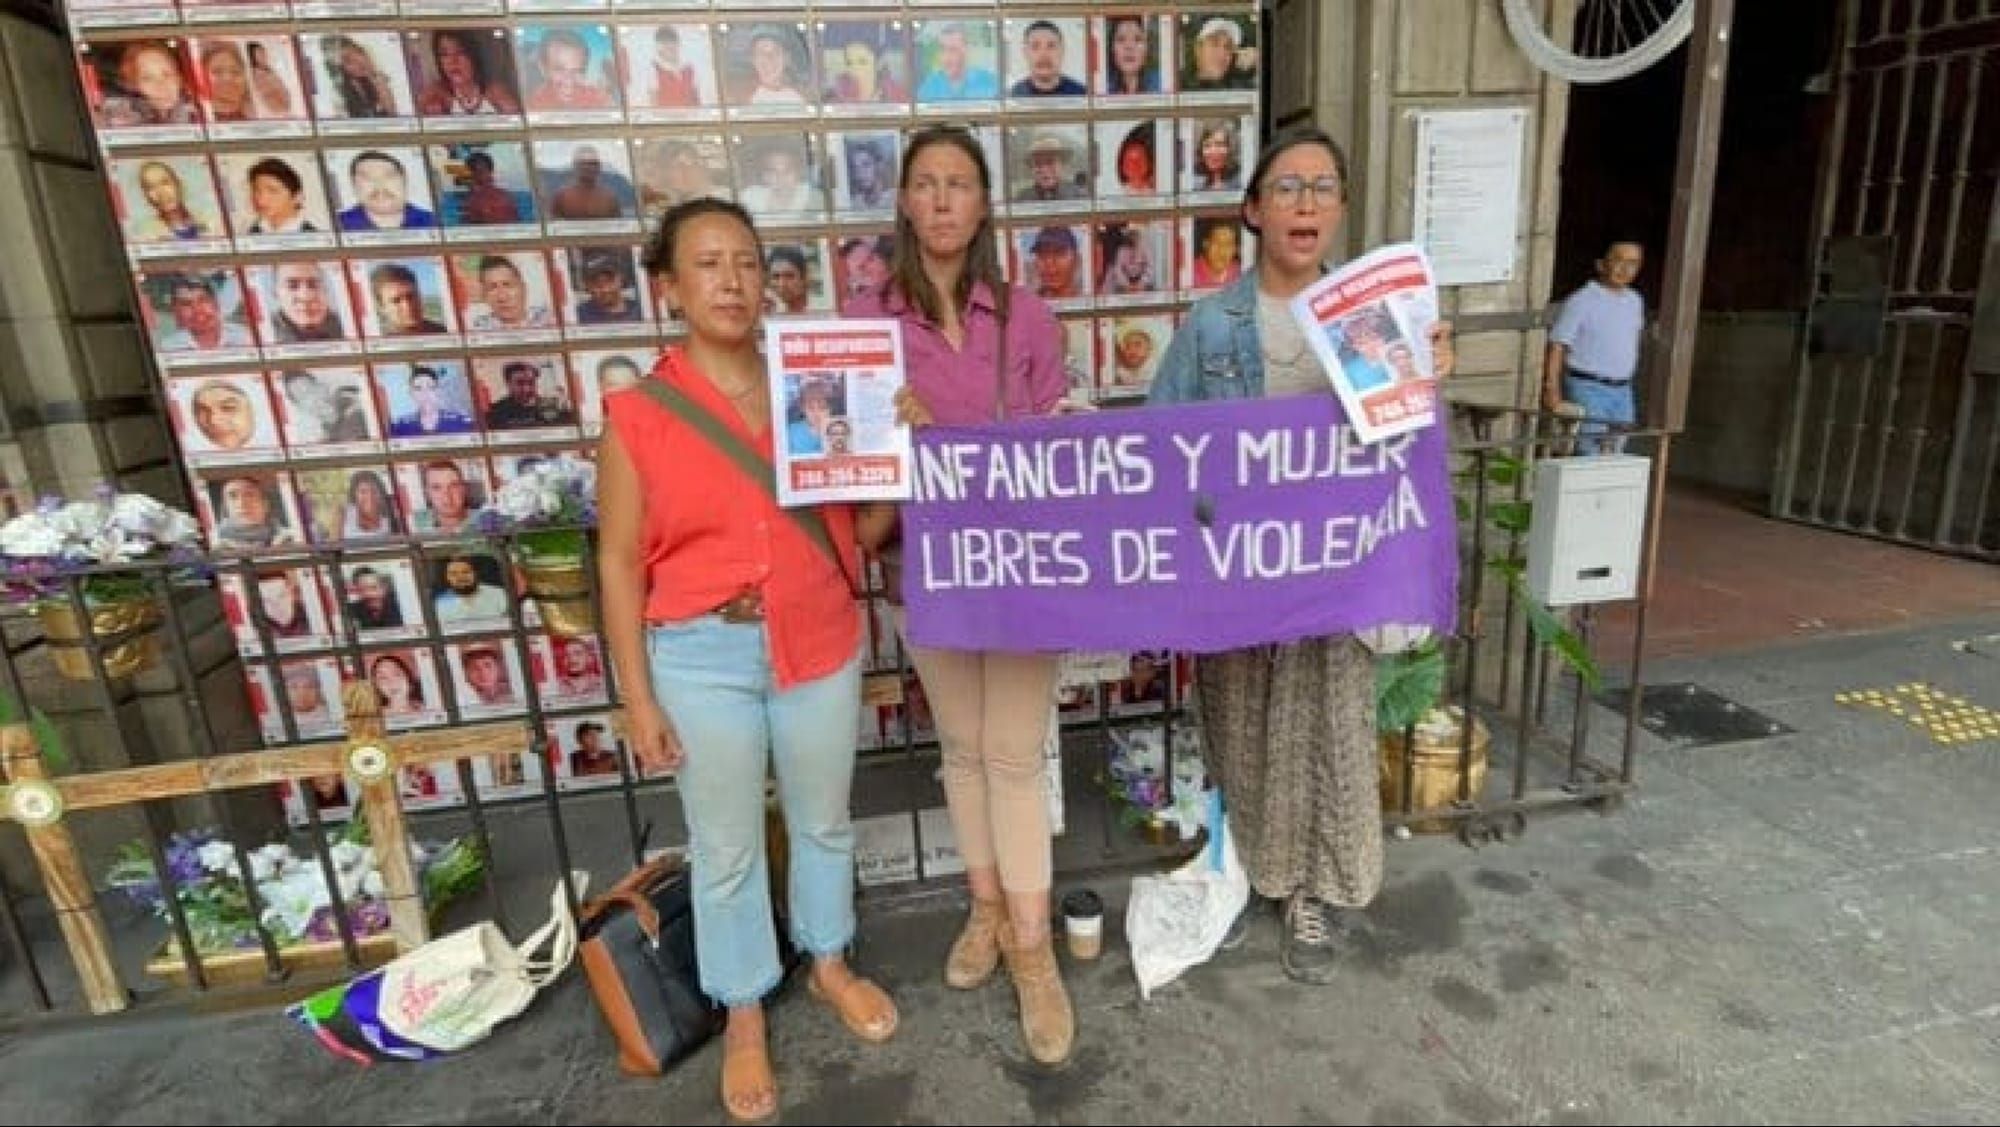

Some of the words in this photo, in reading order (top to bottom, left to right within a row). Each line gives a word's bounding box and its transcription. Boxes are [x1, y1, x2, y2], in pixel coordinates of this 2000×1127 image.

[911, 434, 1154, 503] INFANCIAS
[1171, 431, 1212, 492] Y
[921, 527, 1090, 591] LIBRES
[1111, 527, 1178, 584] DE
